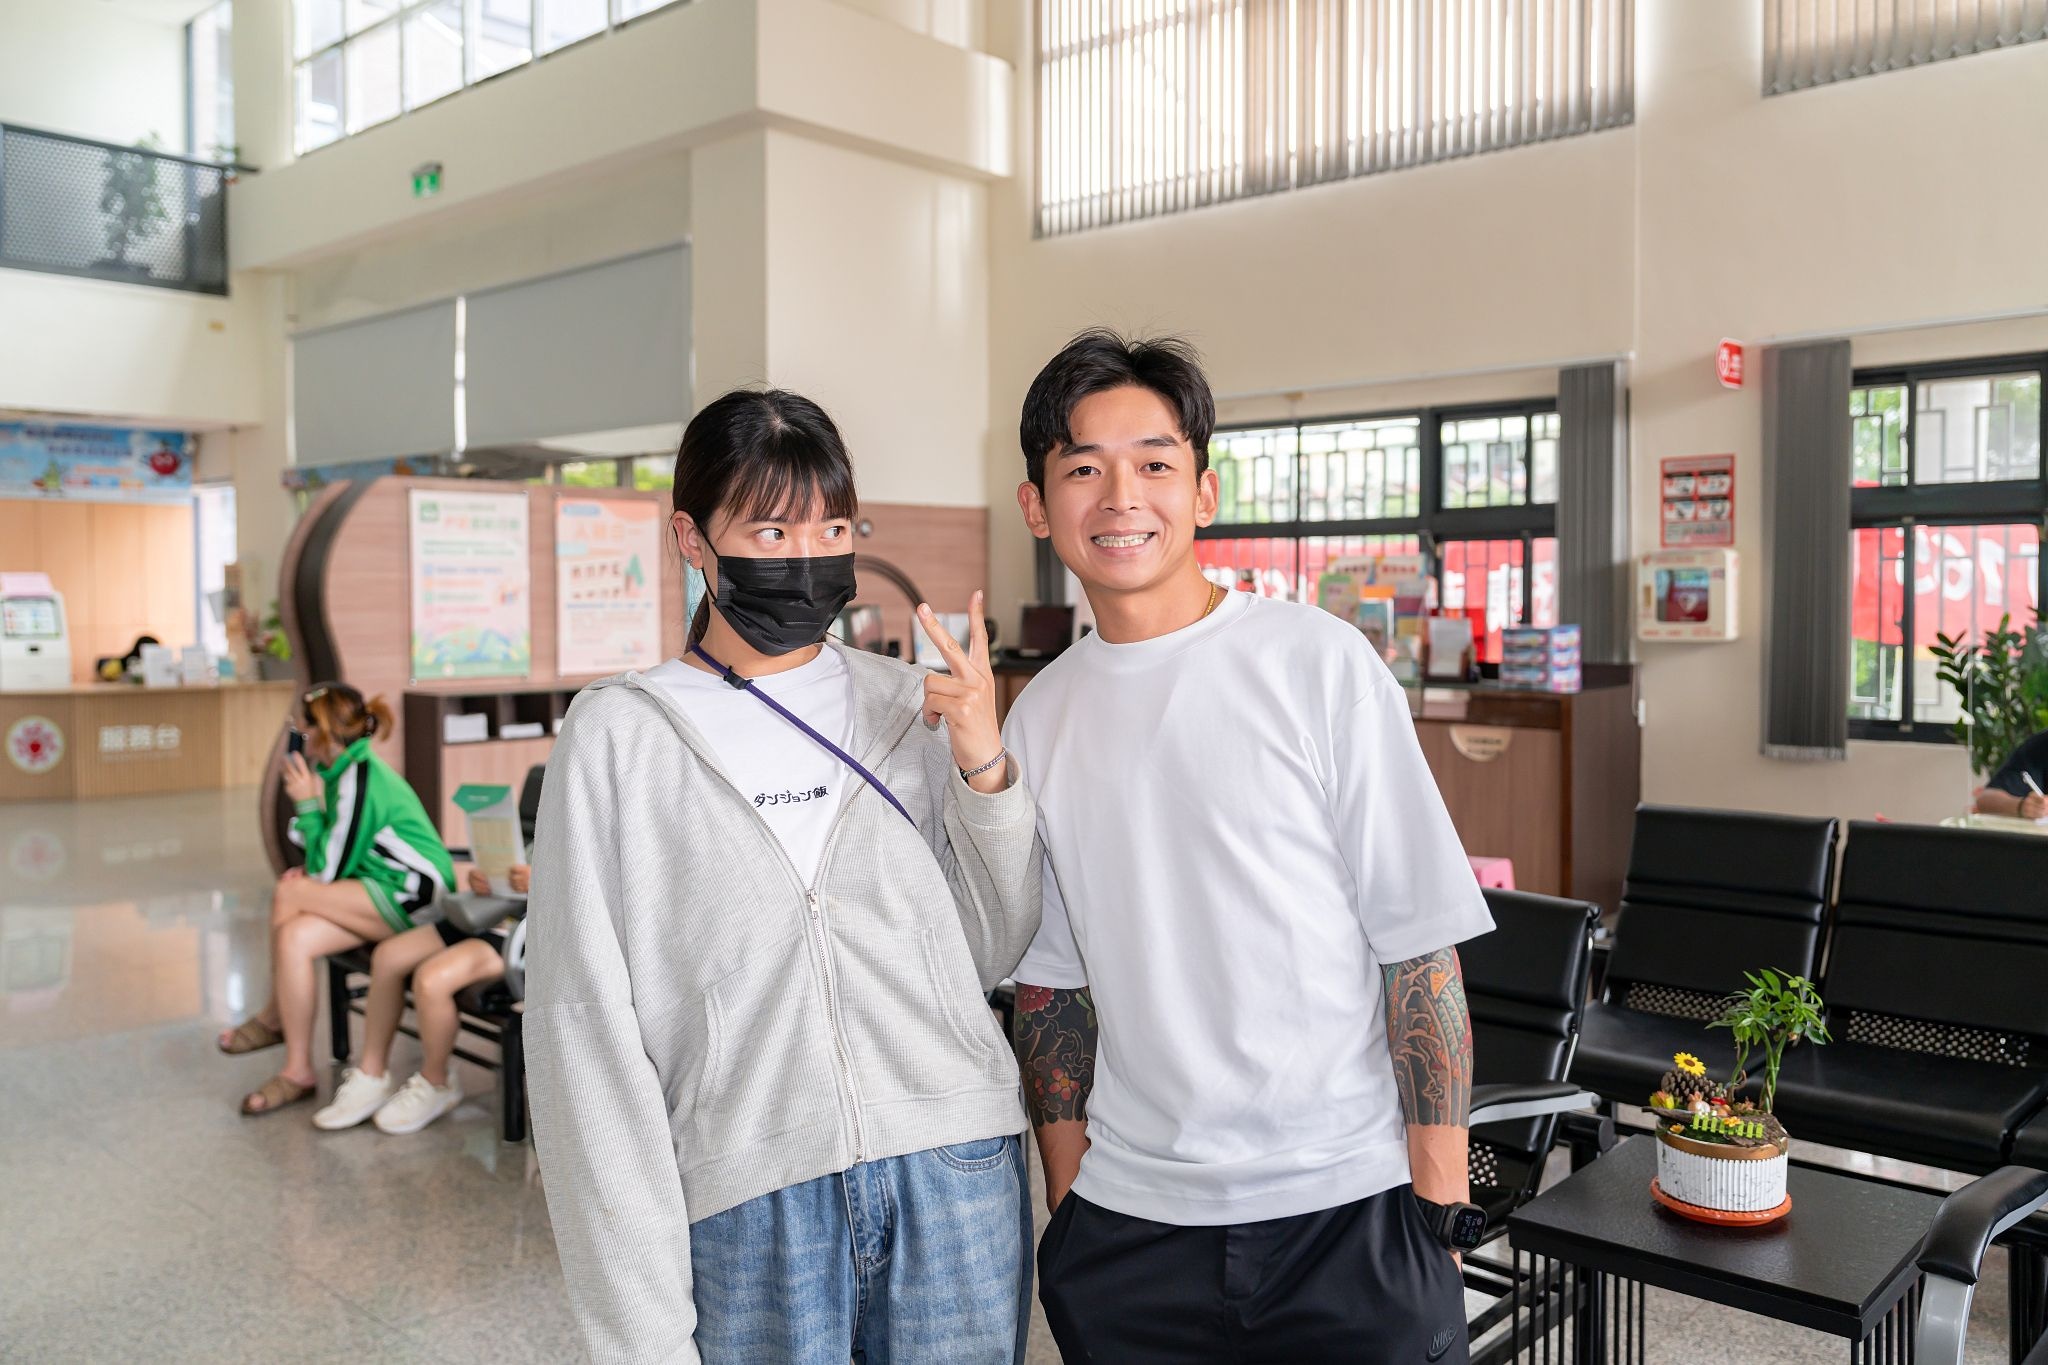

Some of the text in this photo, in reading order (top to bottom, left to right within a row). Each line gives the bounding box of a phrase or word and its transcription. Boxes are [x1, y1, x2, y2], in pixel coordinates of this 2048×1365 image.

[754, 785, 829, 808] ダンジョン飯
[1431, 1325, 1451, 1351] NIKE
